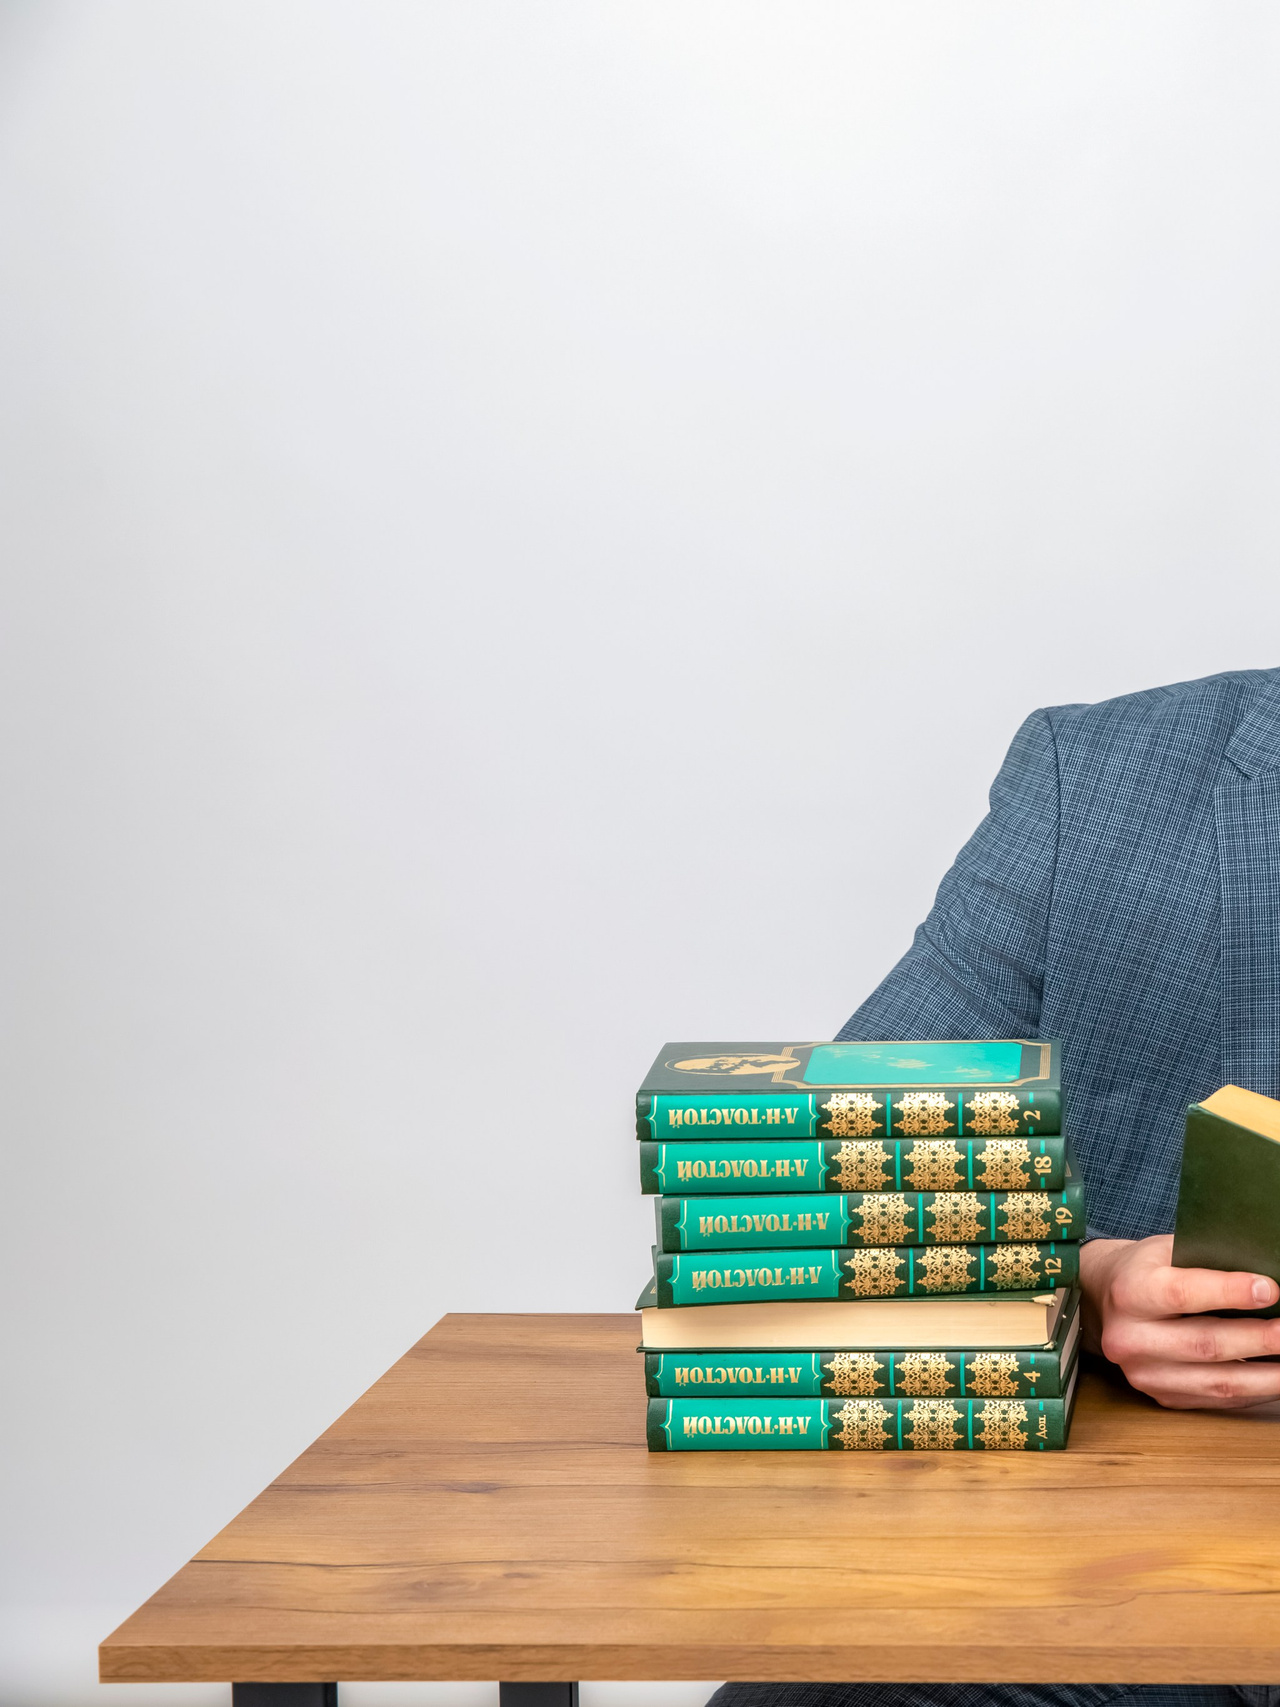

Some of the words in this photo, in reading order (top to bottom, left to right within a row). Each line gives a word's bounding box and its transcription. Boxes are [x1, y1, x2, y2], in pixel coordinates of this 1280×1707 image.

[1023, 1109, 1041, 1121] 2
[1034, 1155, 1052, 1176] 18
[1055, 1206, 1073, 1225] 19
[1044, 1257, 1062, 1275] 12
[1023, 1370, 1041, 1383] 4
